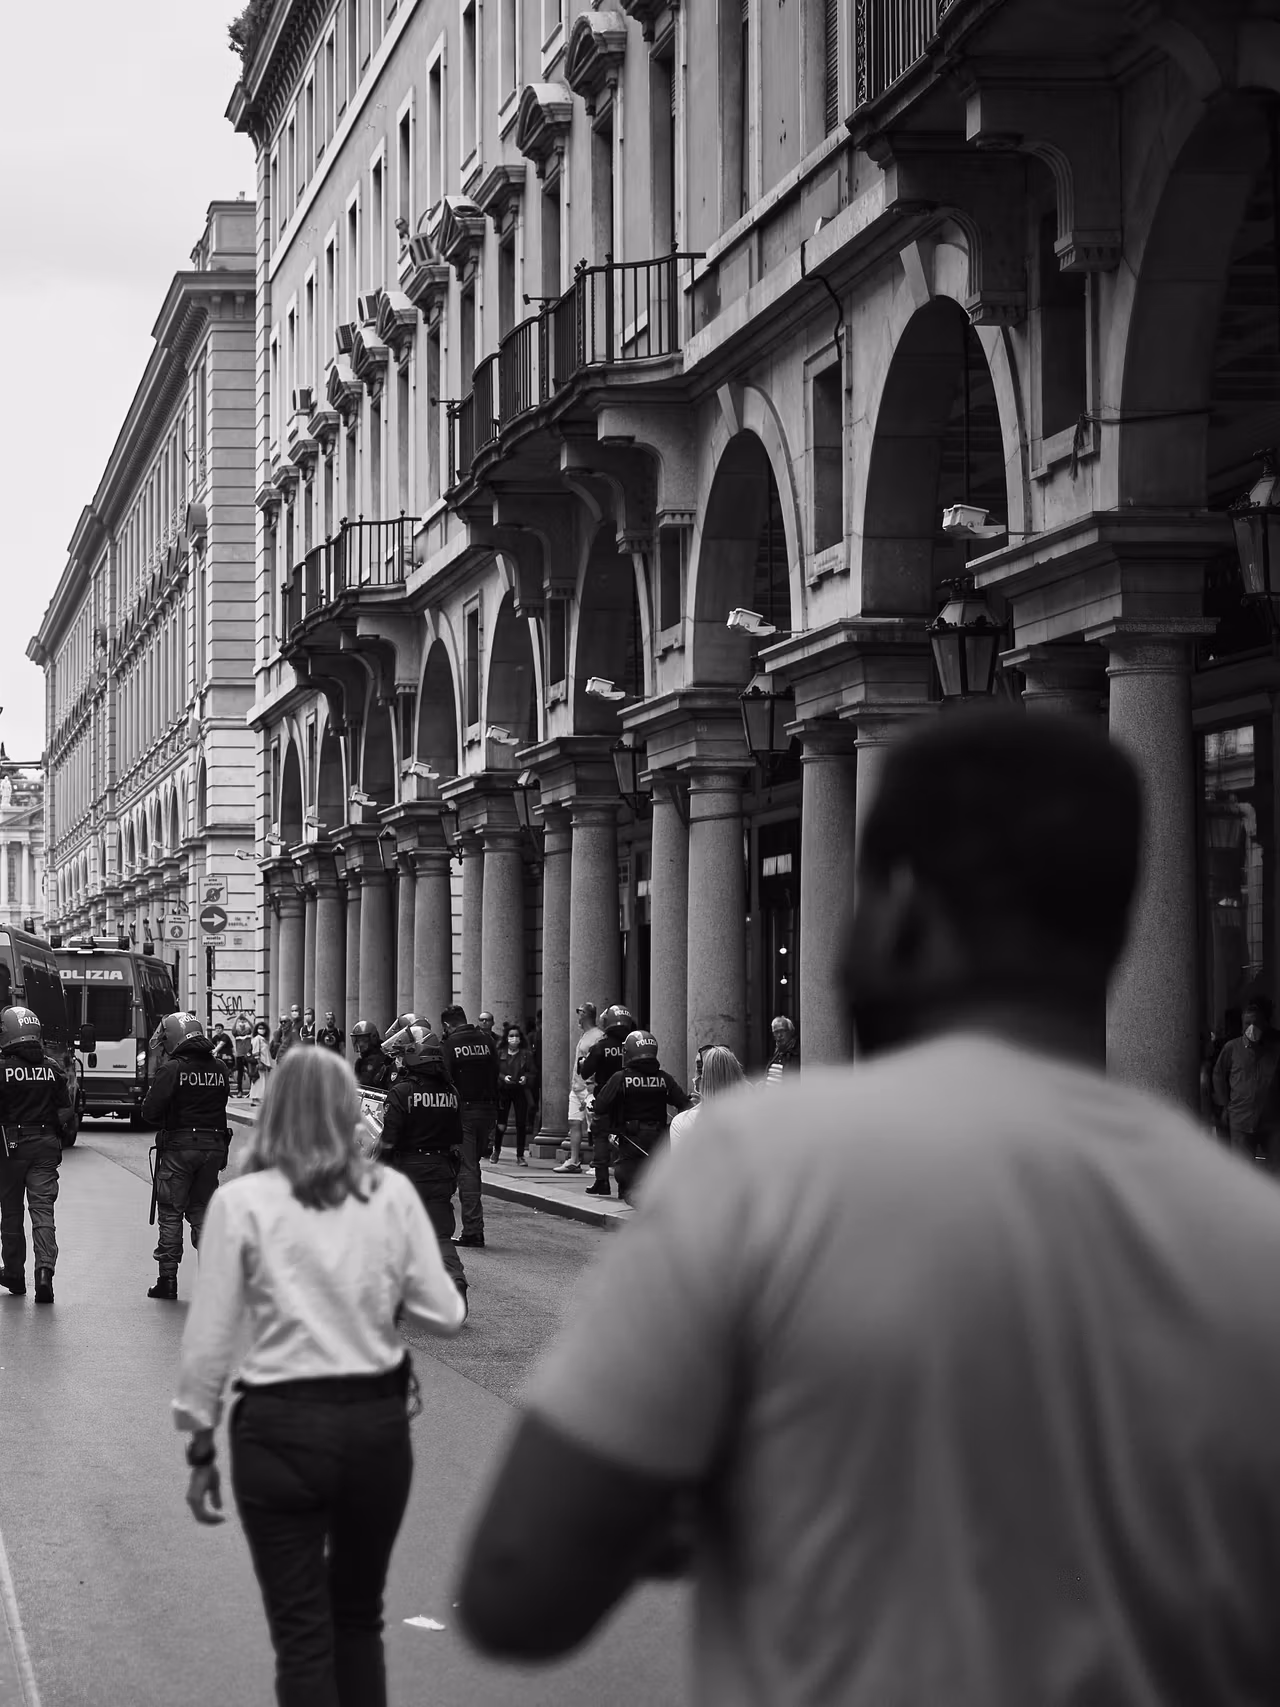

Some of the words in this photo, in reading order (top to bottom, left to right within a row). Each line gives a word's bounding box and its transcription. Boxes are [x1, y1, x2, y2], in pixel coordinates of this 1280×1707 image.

[59, 969, 124, 980] OLIZIA
[454, 1044, 491, 1058] POLIZIA
[5, 1067, 56, 1082] POLIZIA
[179, 1072, 226, 1086] POLIZIA
[625, 1076, 667, 1088] POLIZIA
[413, 1092, 454, 1107] POLIZIA
